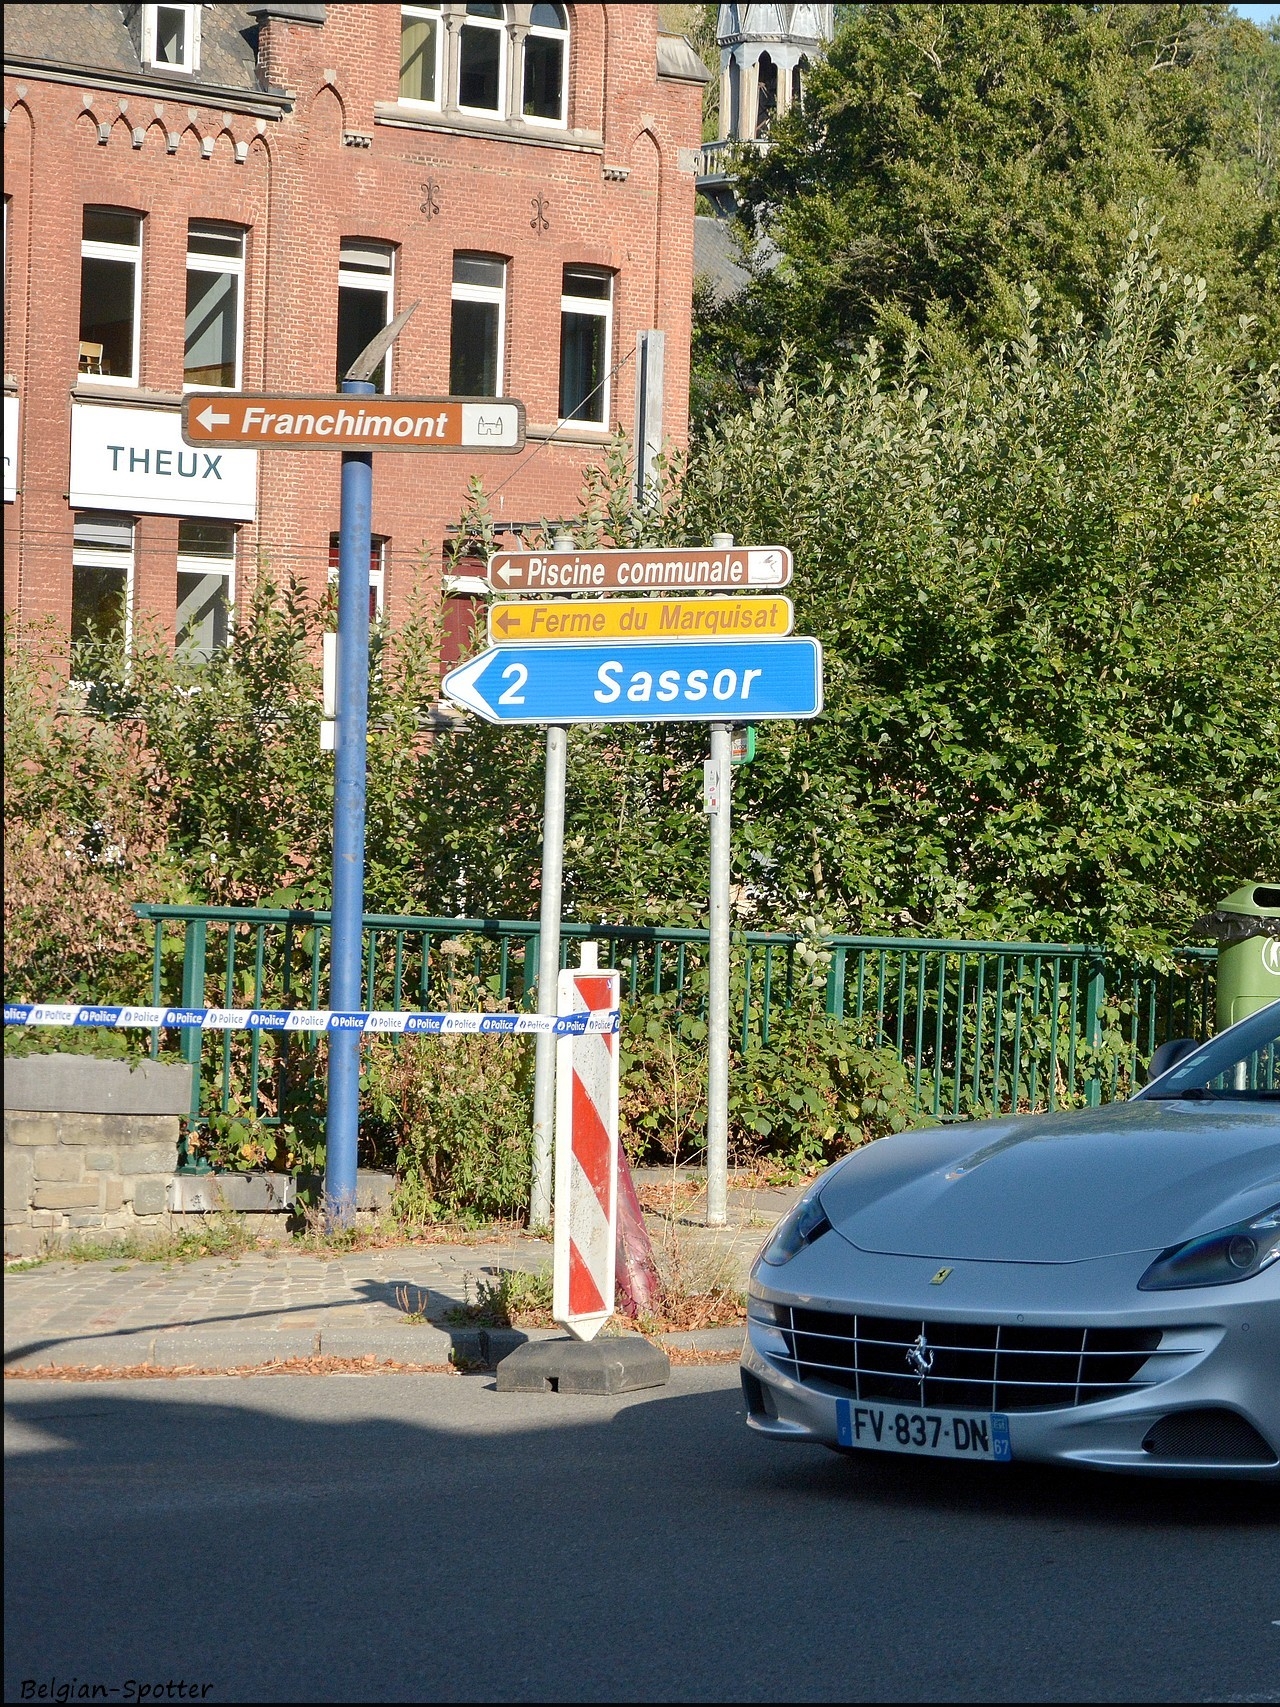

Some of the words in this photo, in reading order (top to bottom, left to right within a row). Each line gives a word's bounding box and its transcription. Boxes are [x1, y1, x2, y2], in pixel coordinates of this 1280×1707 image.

[241, 407, 448, 438] Franchimont
[106, 445, 223, 481] THEUX
[527, 556, 605, 586] Piscine
[617, 553, 743, 584] communale
[530, 607, 606, 633] Ferme
[619, 606, 648, 631] du
[659, 604, 779, 634] Marquisat
[498, 663, 529, 705] 2
[593, 660, 762, 705] Sassor
[4, 1007, 27, 1020] olice
[45, 1009, 72, 1020] Police
[90, 1010, 117, 1022] Police
[133, 1011, 159, 1022] Police
[176, 1012, 203, 1024] Police
[218, 1013, 244, 1024] Police
[260, 1014, 285, 1025] Police
[300, 1015, 324, 1026] Police
[339, 1016, 364, 1027] Police
[379, 1017, 402, 1028] Police
[417, 1018, 440, 1029] Police
[454, 1019, 476, 1029] Police
[491, 1019, 513, 1030] Police
[527, 1020, 550, 1030] Police
[565, 1019, 585, 1031] Police
[595, 1019, 611, 1030] Police
[993, 1439, 1009, 1455] 67
